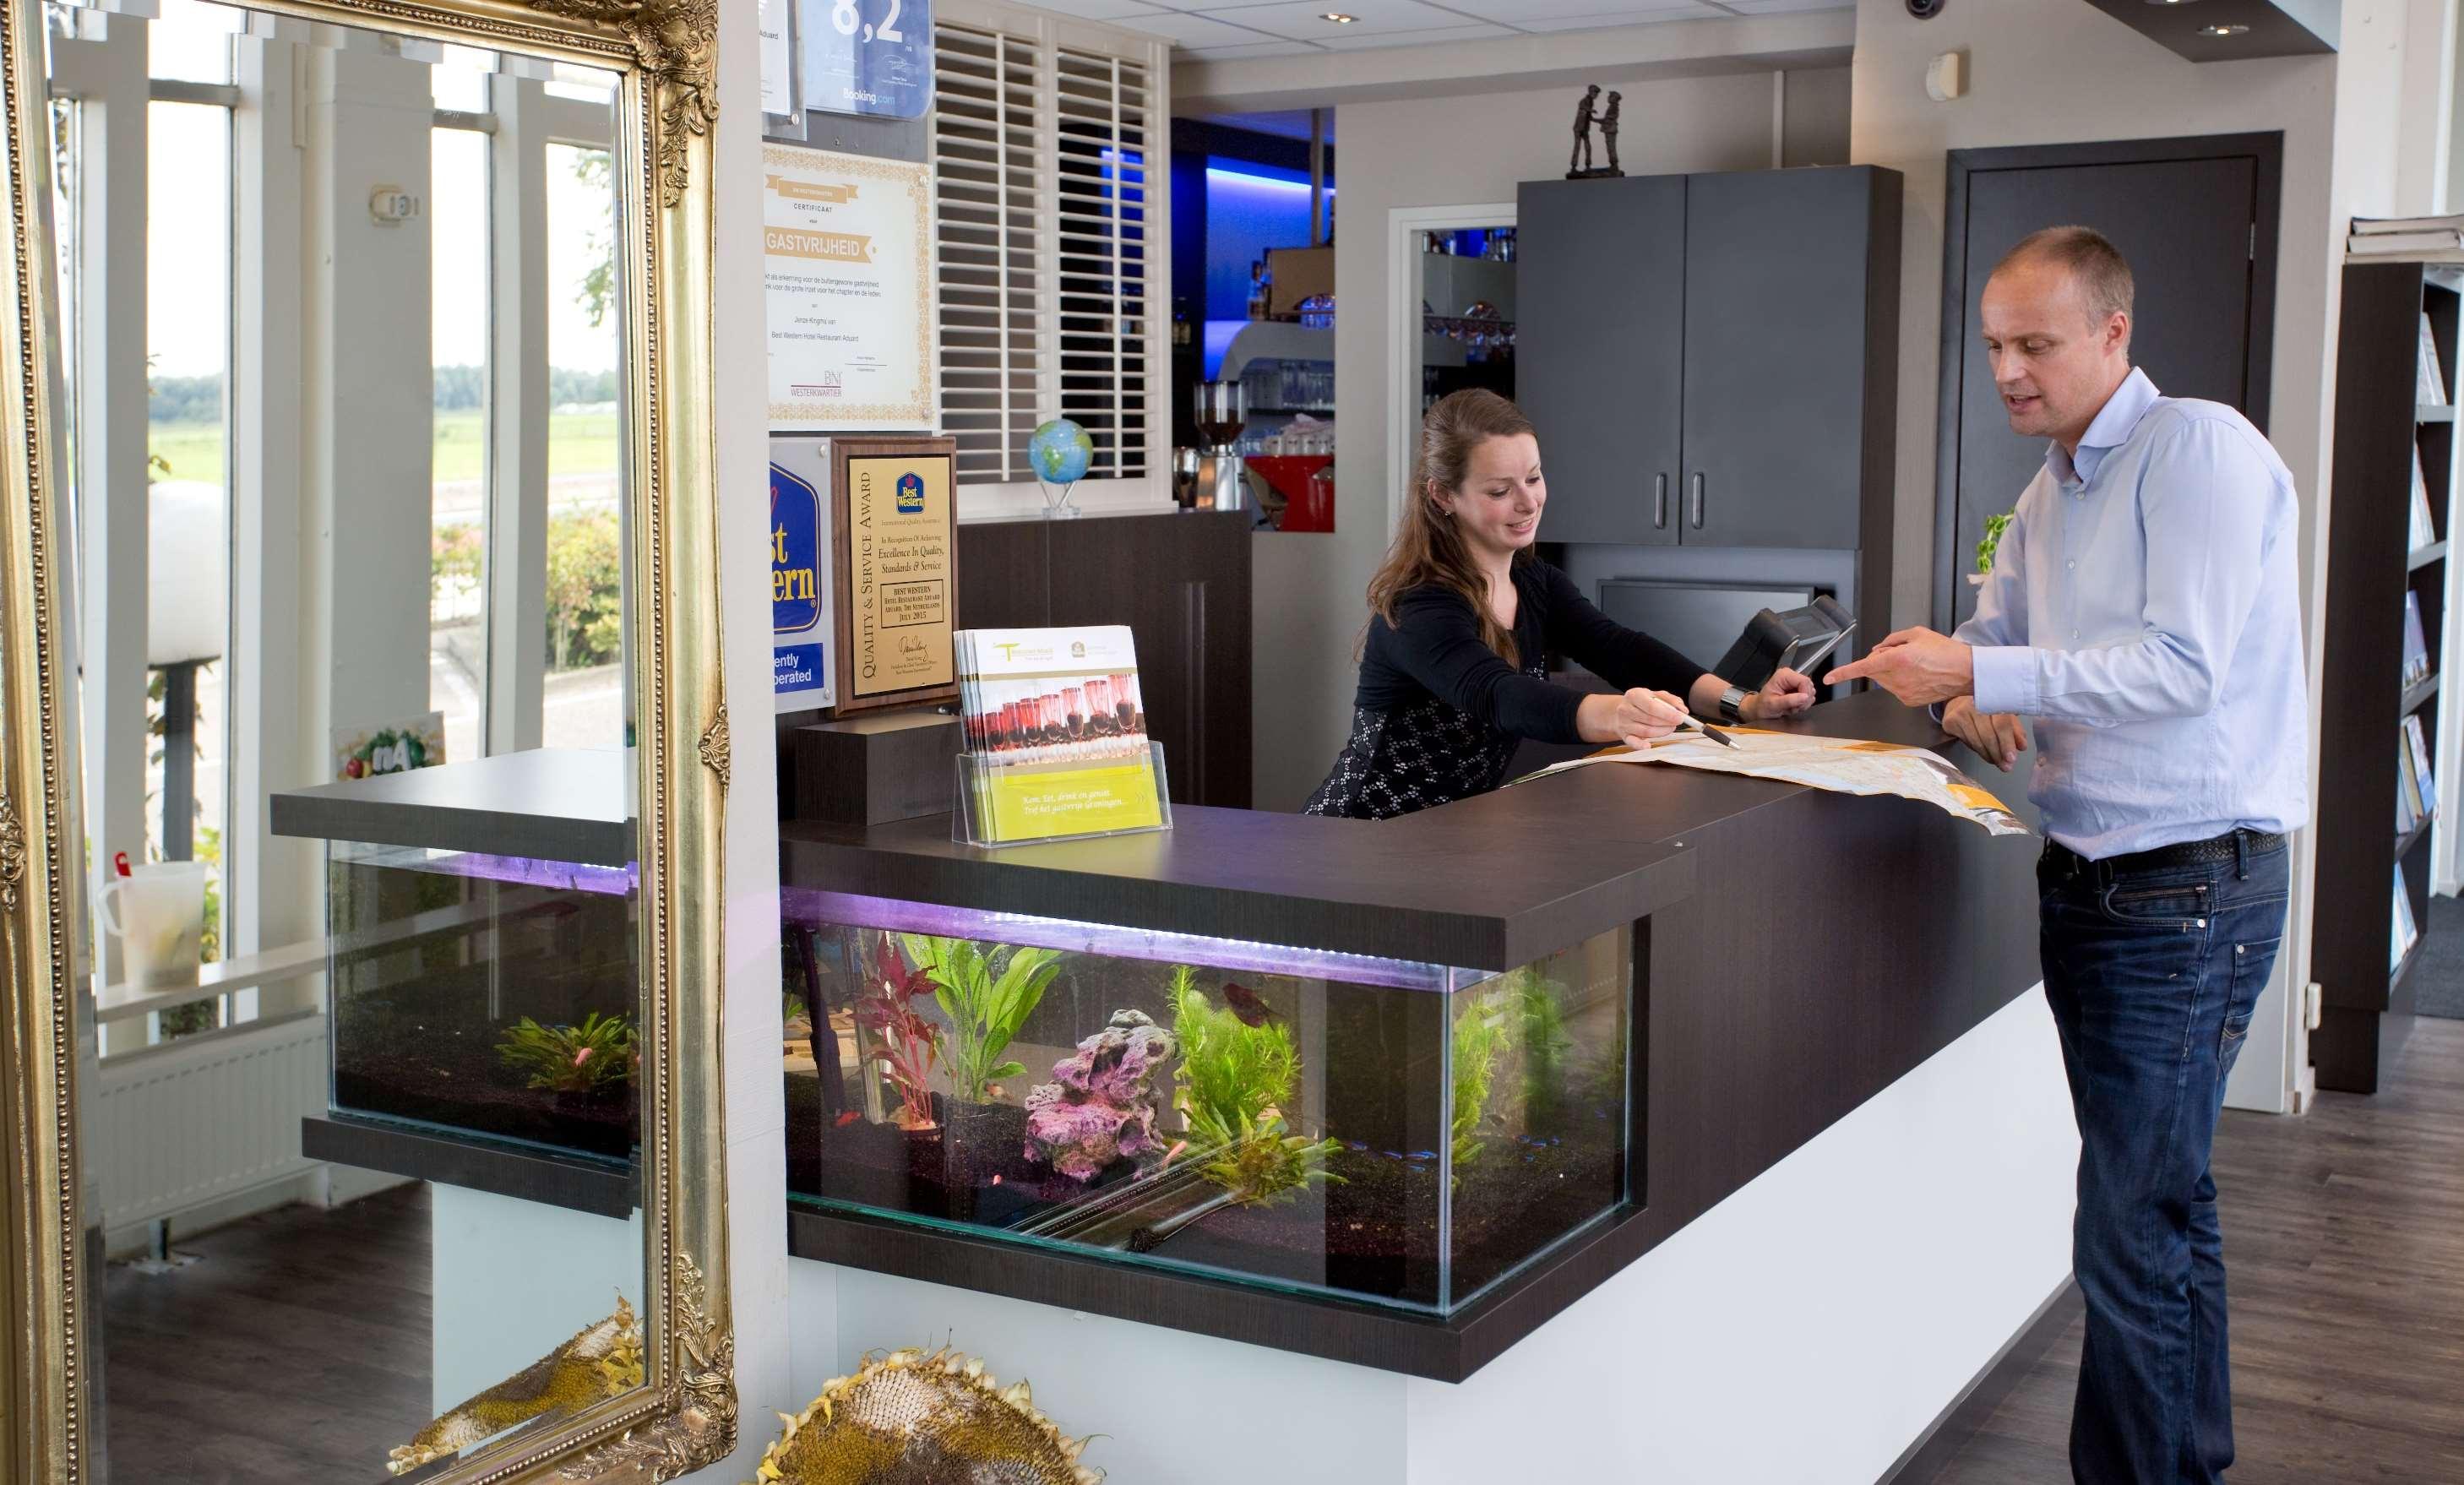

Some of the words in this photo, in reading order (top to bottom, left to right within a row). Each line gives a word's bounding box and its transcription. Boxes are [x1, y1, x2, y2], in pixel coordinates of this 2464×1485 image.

[843, 87, 895, 106] Booking.com
[793, 203, 832, 213] CERTIFICAAT
[765, 232, 859, 256] GASTVRIJHEID
[771, 330, 783, 339] Best
[784, 330, 802, 340] Western
[817, 332, 840, 341] Restaurant
[842, 333, 859, 342] Aduard
[791, 388, 842, 398] WESTERKWARTIER
[902, 487, 917, 498] Best
[859, 471, 872, 528] AWARD
[897, 495, 923, 507] Western
[888, 535, 912, 544] Recognition
[921, 534, 942, 543] Achieving
[878, 547, 911, 559] Excellence
[912, 546, 919, 557] In
[920, 545, 944, 558] Quality,
[861, 535, 873, 594] SERVICE
[881, 561, 912, 574] Standards
[921, 560, 942, 570] Service
[907, 585, 931, 594] WESTERN
[864, 597, 873, 609] &
[899, 613, 911, 622] JULY
[913, 611, 927, 620] 2015
[862, 613, 876, 678] QUALITY
